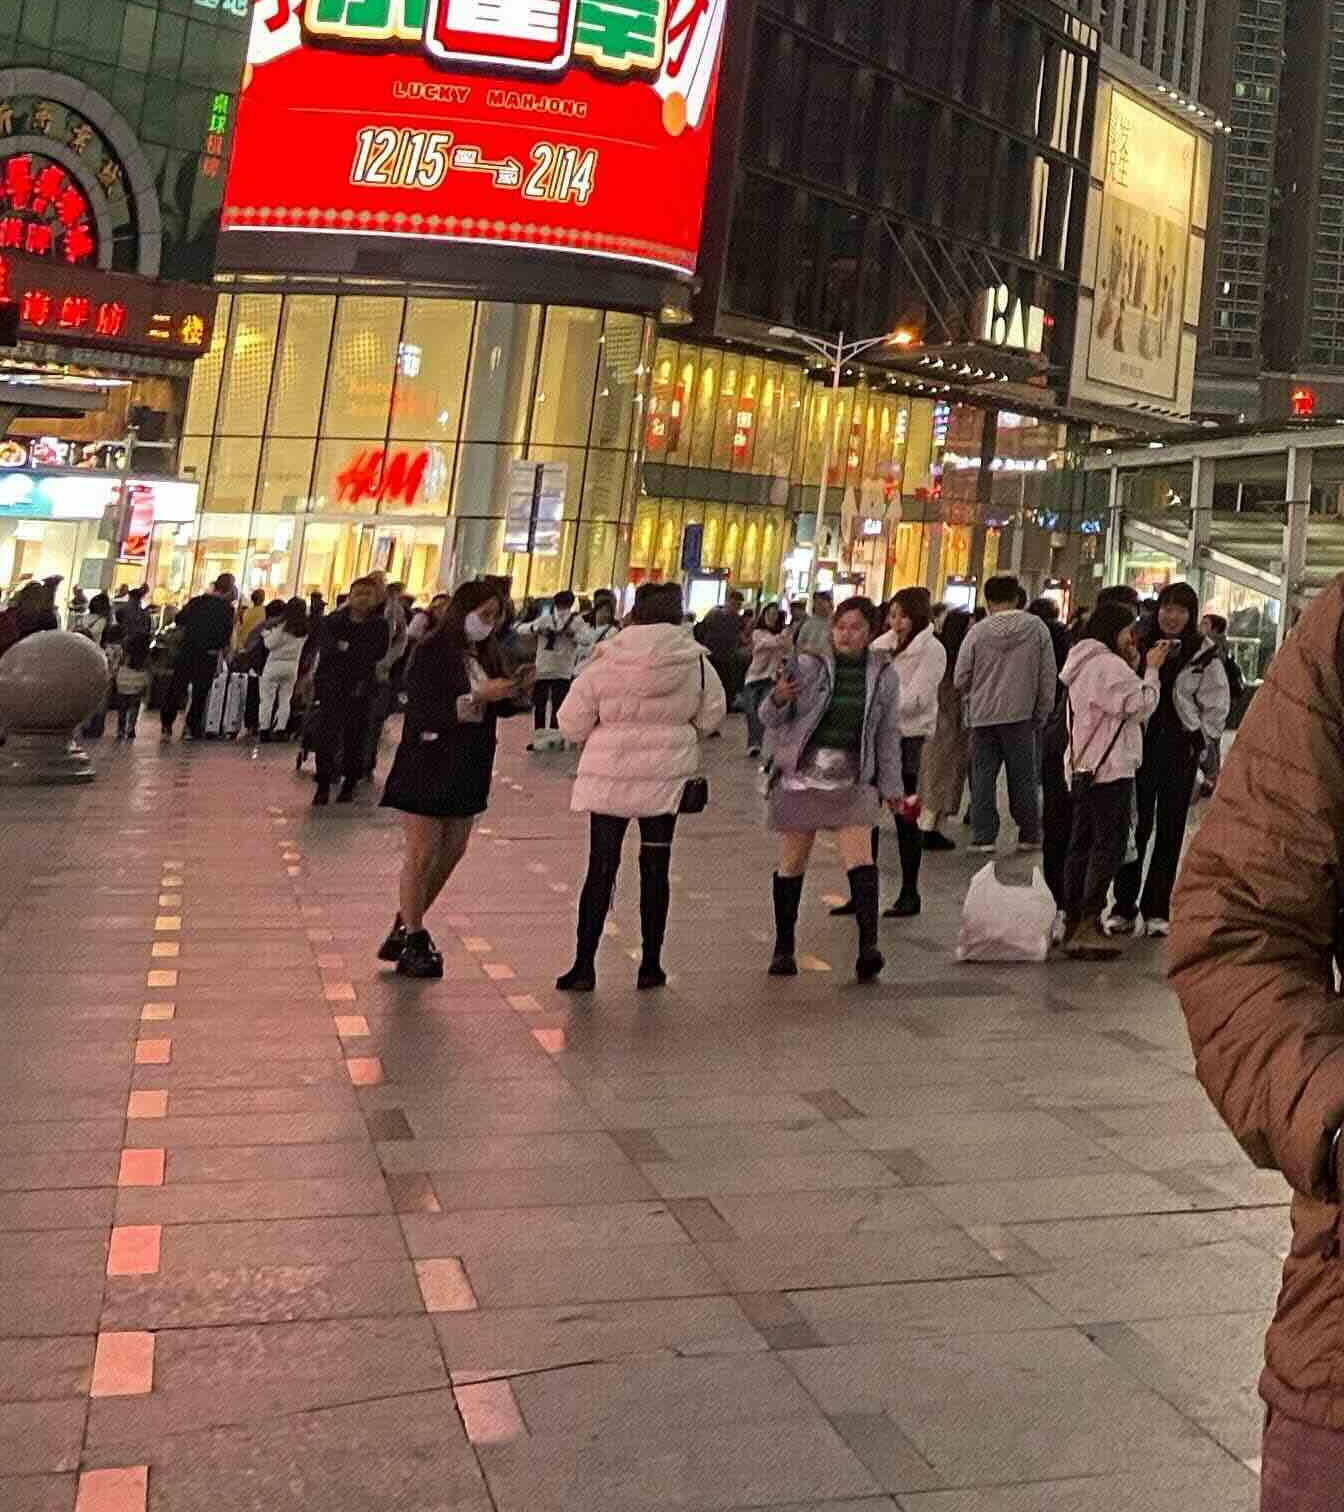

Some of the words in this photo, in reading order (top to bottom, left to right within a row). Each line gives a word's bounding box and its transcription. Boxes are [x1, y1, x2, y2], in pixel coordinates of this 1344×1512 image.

[393, 81, 472, 103] LUCKY
[486, 89, 588, 118] MAHJONG
[353, 127, 452, 188] 12/15
[524, 142, 597, 203] 2/14
[335, 446, 431, 506] H&M
